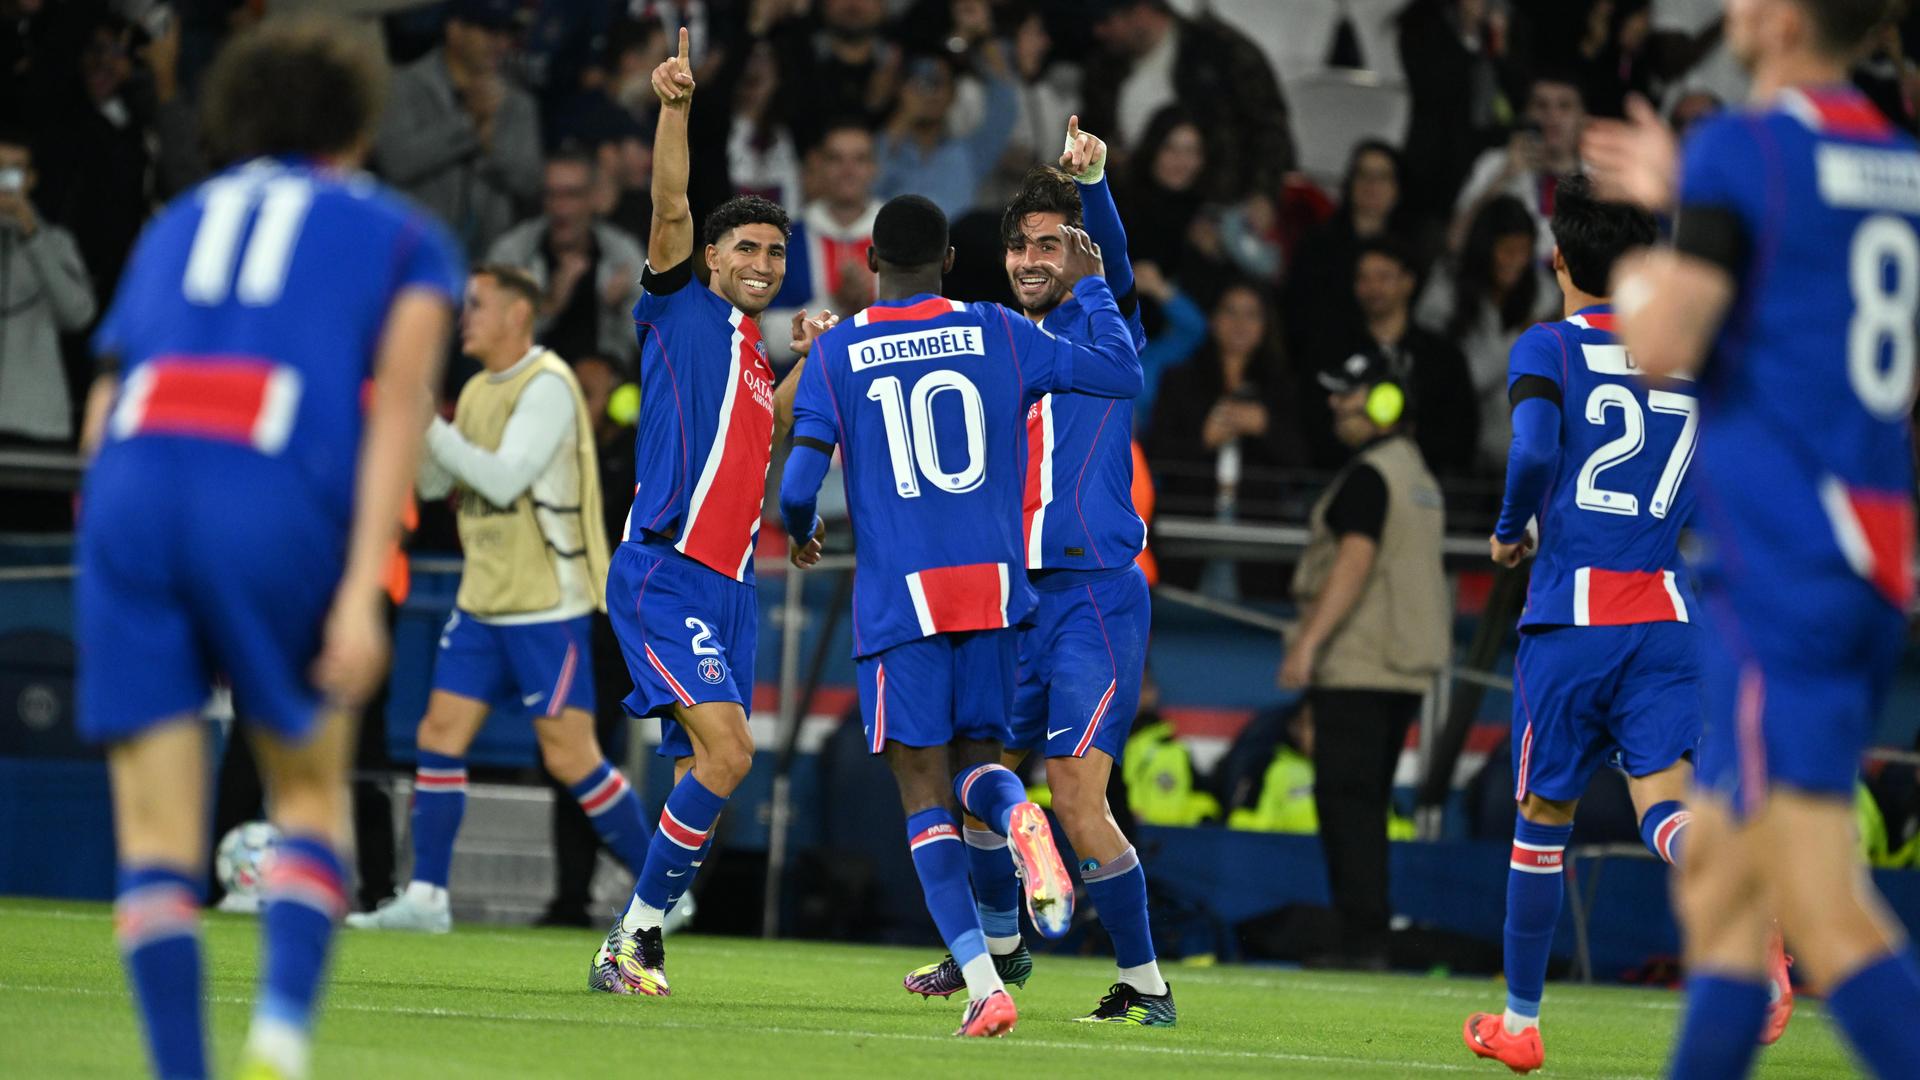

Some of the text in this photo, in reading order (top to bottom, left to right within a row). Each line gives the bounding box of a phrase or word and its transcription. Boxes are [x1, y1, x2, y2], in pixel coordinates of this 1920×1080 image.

[183, 174, 313, 307] 11
[860, 330, 975, 365] O.DEMBÉLÉ
[1847, 213, 1919, 421] 8
[866, 369, 986, 498] 10
[1575, 383, 1700, 519] 27
[685, 617, 719, 655] 2
